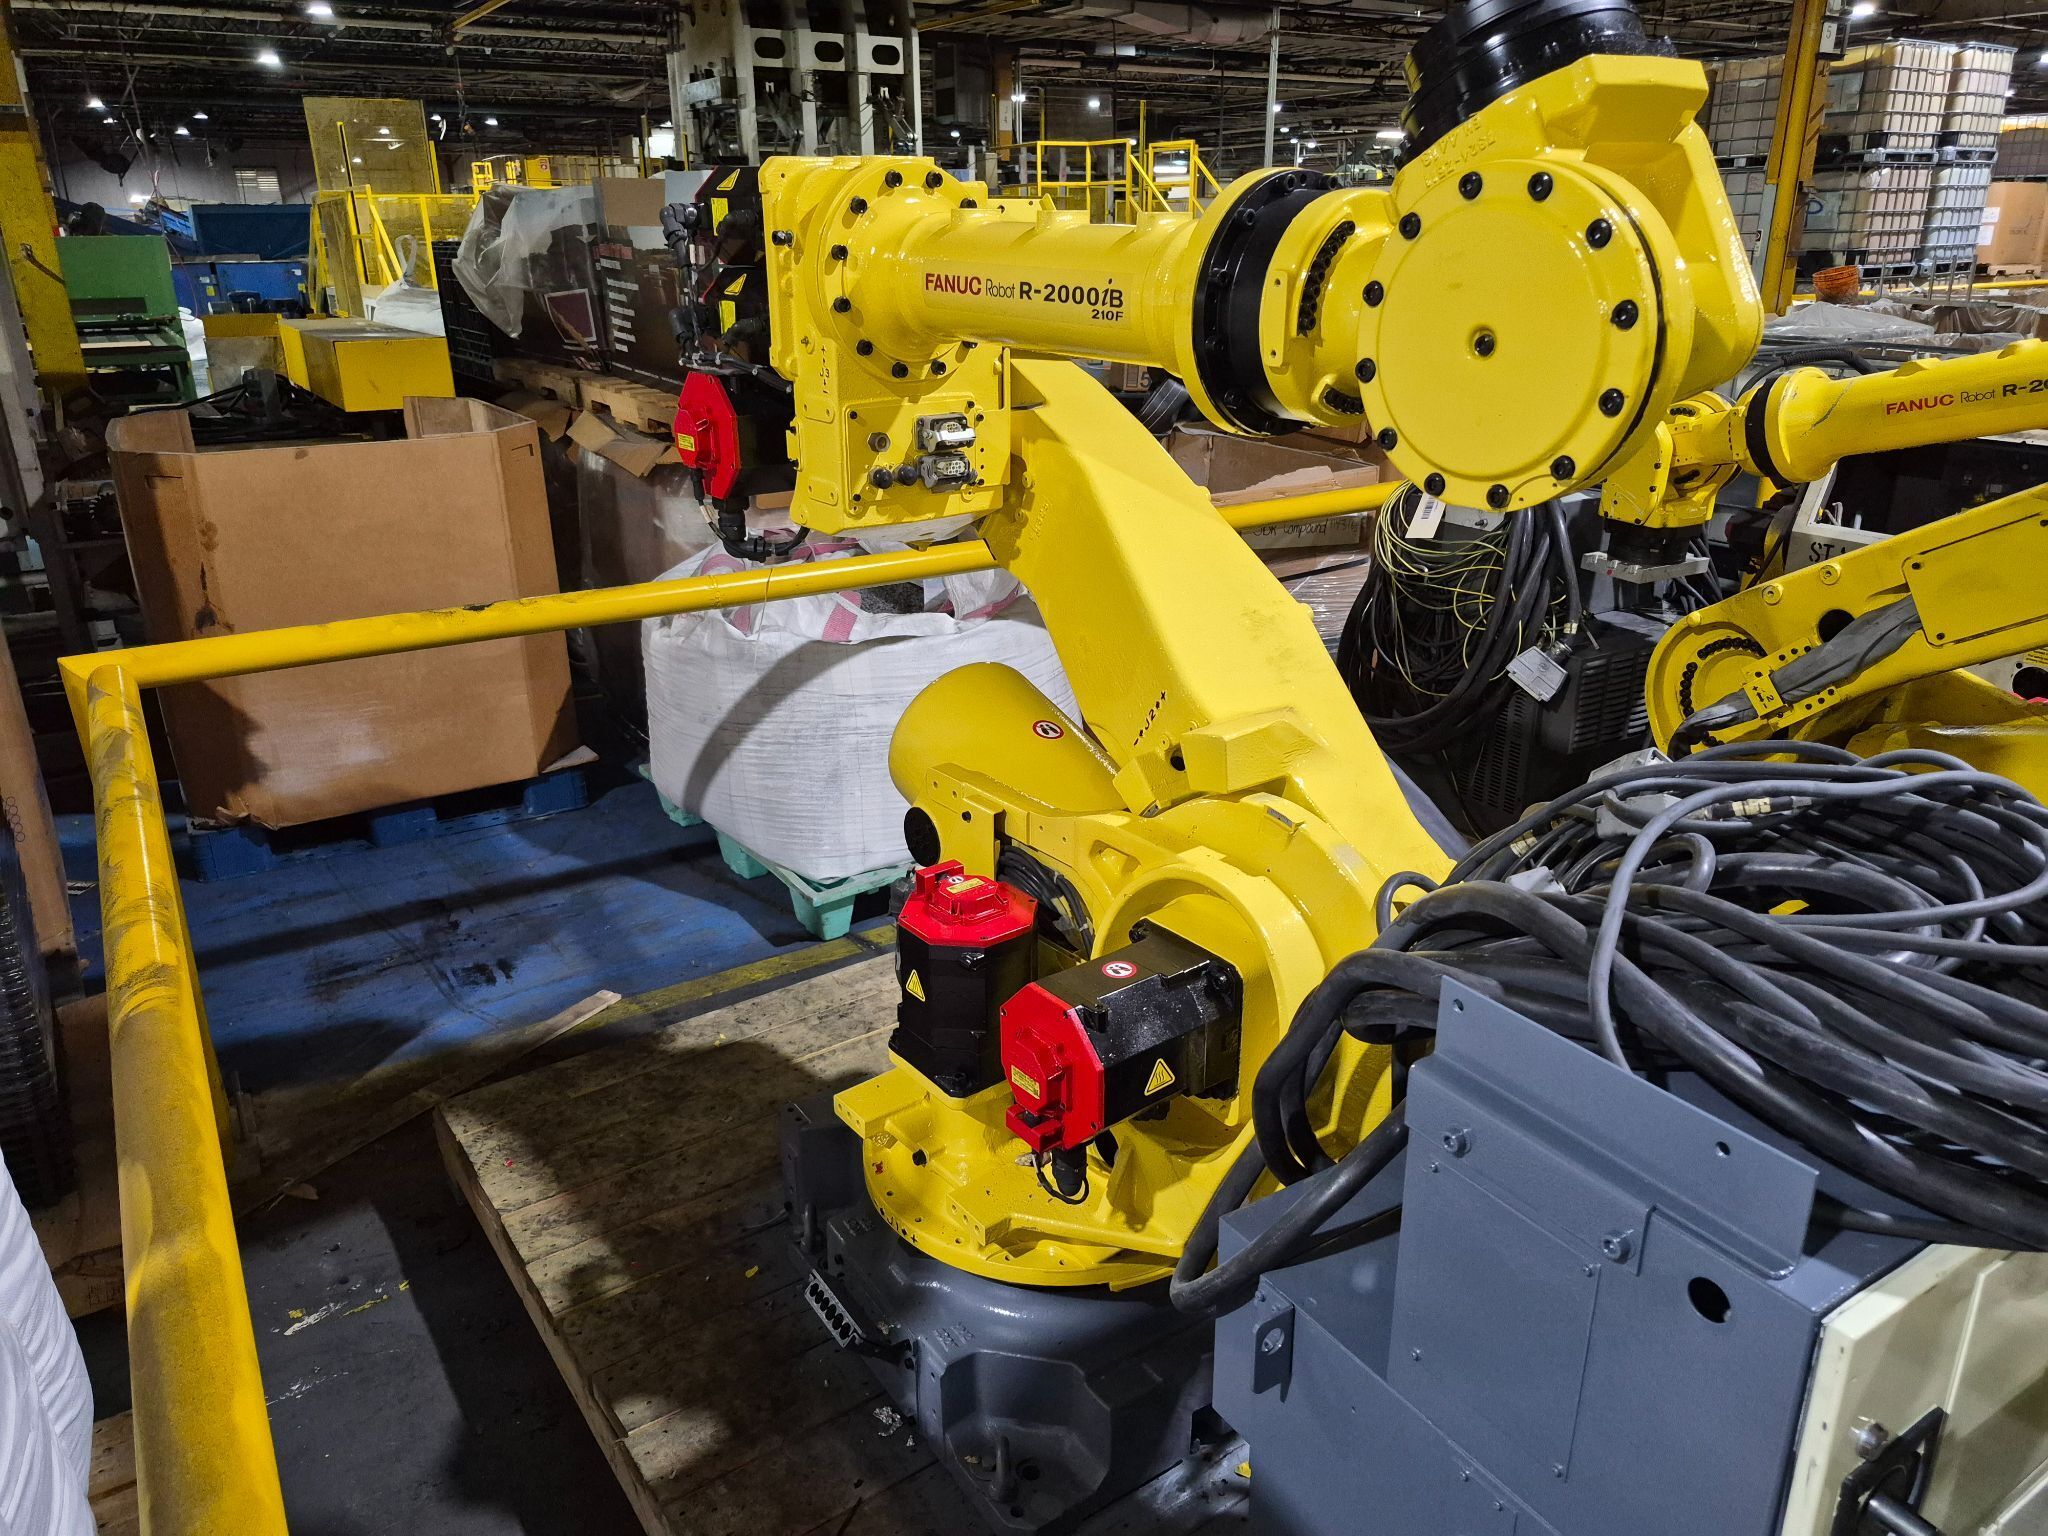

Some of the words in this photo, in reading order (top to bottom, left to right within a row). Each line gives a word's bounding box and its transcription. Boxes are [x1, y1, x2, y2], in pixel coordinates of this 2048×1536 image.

[925, 273, 982, 296] FANUC
[985, 278, 1016, 299] Robot
[1019, 278, 1124, 309] R-2000iB
[1091, 308, 1124, 322] 210F
[1886, 394, 1954, 416] FANUC
[1960, 389, 1996, 404] Robot
